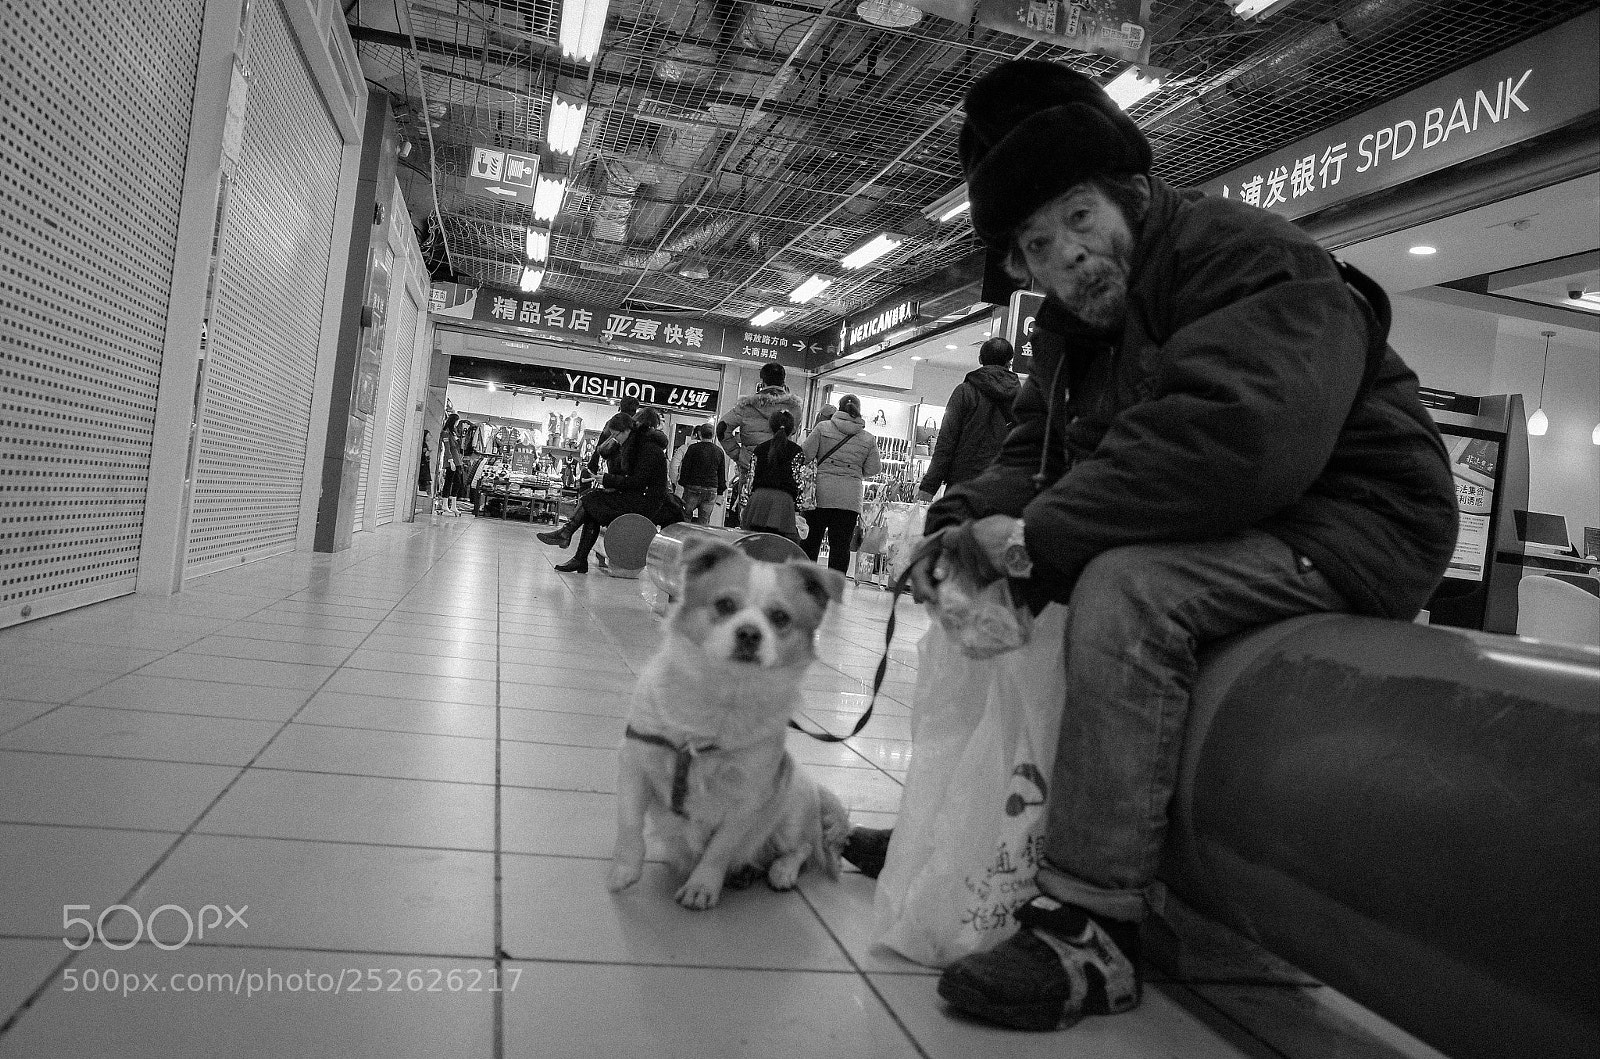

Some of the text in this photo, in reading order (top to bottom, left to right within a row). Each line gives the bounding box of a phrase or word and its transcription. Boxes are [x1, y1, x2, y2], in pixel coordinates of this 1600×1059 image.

[1240, 69, 1533, 208] 浦发银行 SPD BANK
[491, 295, 593, 332] 精品名店
[742, 345, 778, 360] 大商男店
[744, 331, 788, 348] 解放路方向
